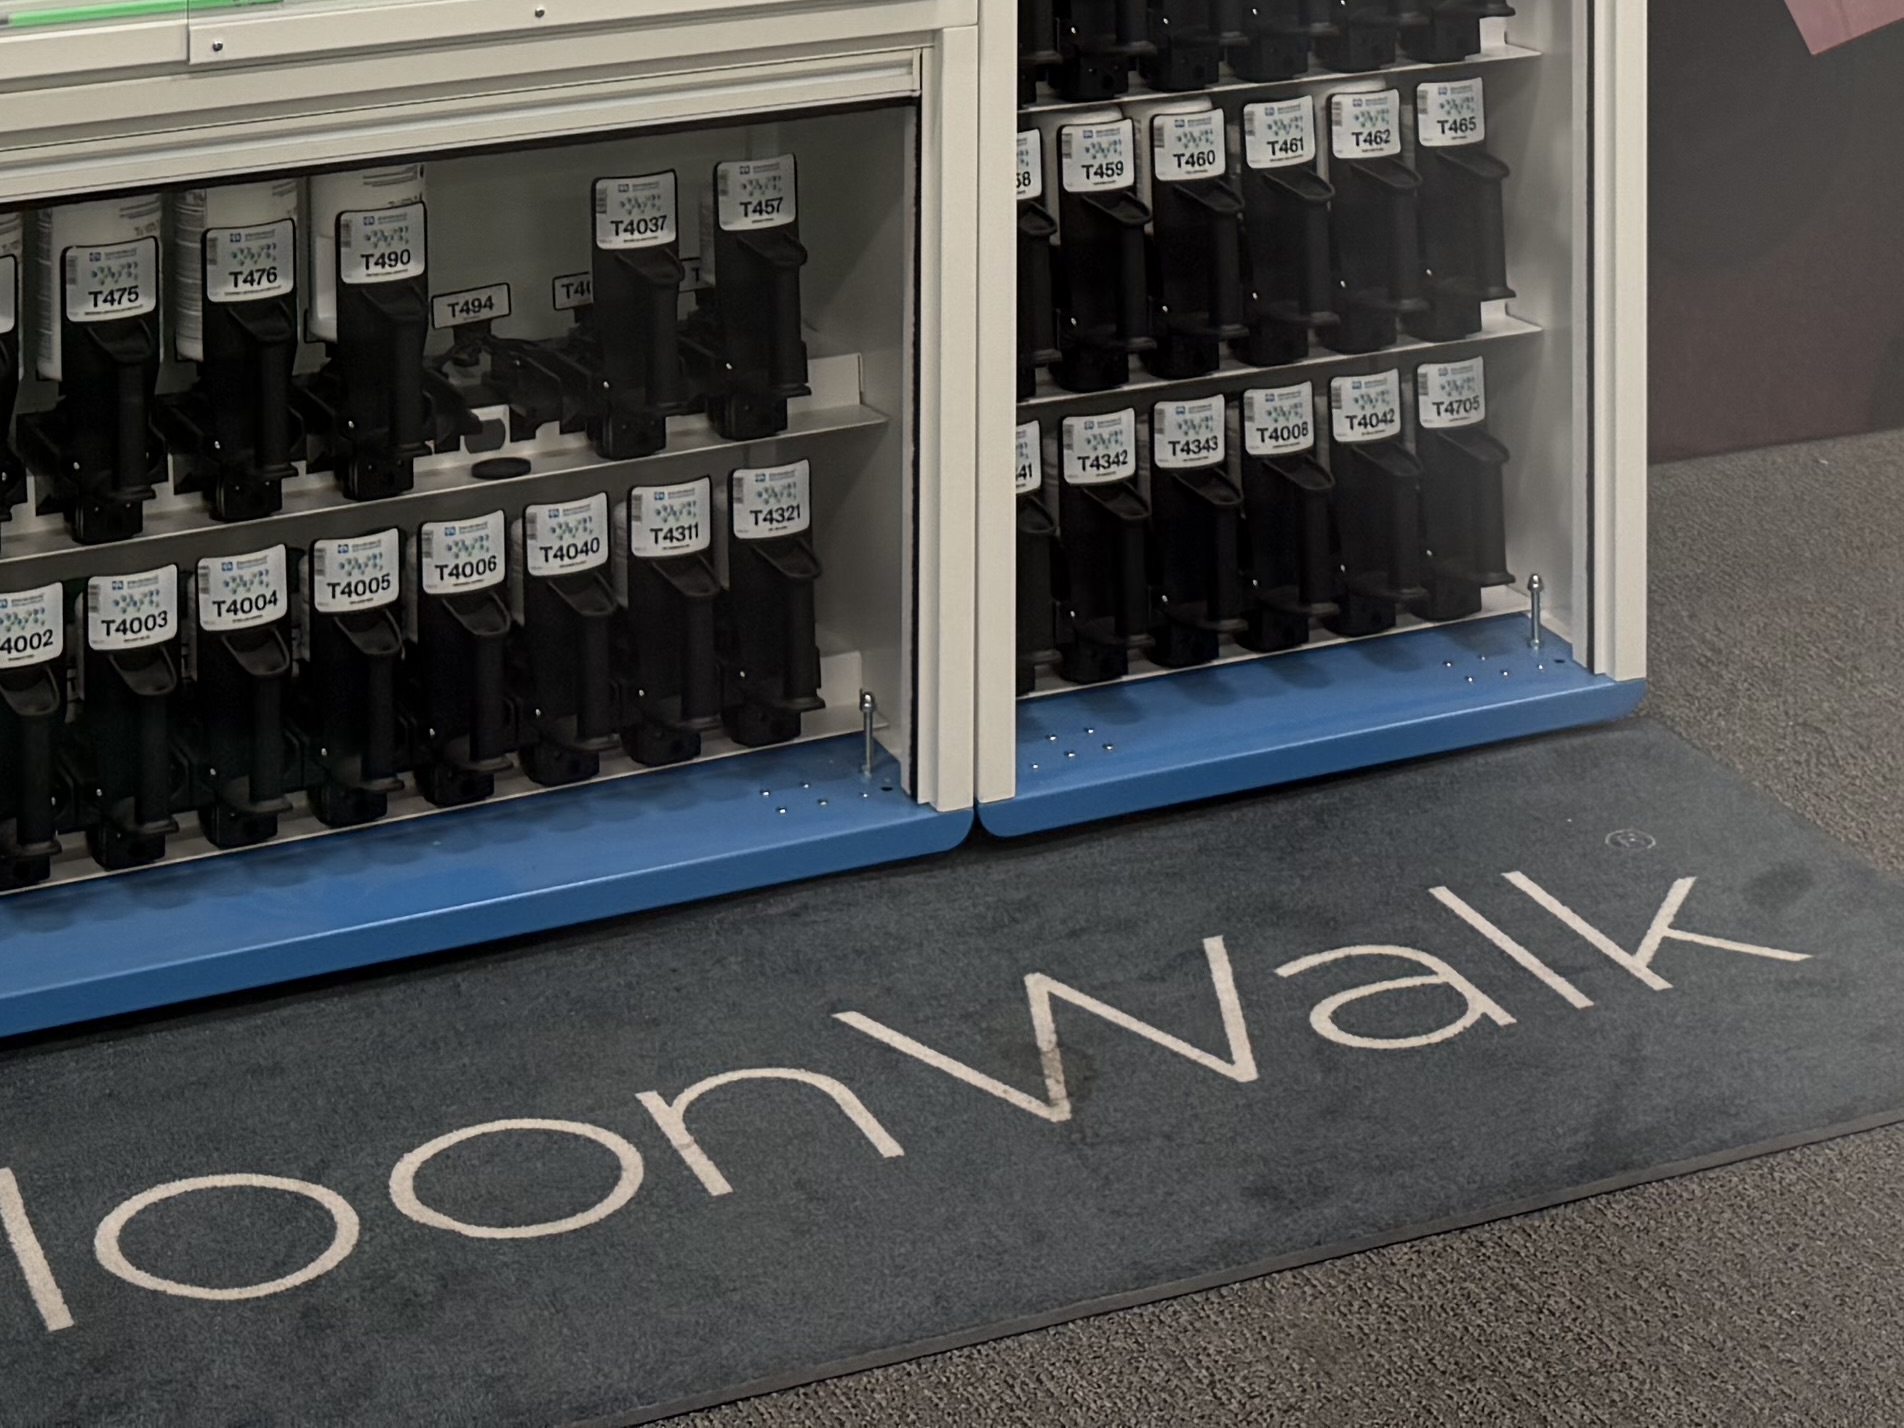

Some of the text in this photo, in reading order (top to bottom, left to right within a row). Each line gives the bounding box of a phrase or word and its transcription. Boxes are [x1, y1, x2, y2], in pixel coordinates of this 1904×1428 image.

[1437, 116, 1477, 135] T465
[1266, 137, 1304, 157] T461
[1351, 129, 1391, 147] T462
[1081, 160, 1124, 180] T459
[1172, 149, 1216, 169] T460
[739, 197, 784, 218] T457
[610, 214, 668, 238] T4037
[360, 249, 411, 272] T490
[228, 266, 278, 289] T476
[88, 285, 139, 309] T475
[447, 295, 495, 319] T494
[1432, 395, 1480, 418] T4705
[1345, 408, 1395, 431] T4042
[1167, 435, 1219, 457] T4343
[1077, 449, 1128, 472] T4342
[750, 504, 801, 526] T4321
[650, 522, 699, 546] T4311
[539, 537, 600, 564] T4040
[435, 555, 498, 581] T4006
[327, 573, 391, 600] T4005
[212, 593, 279, 619] T4004
[101, 610, 169, 638] T4003
